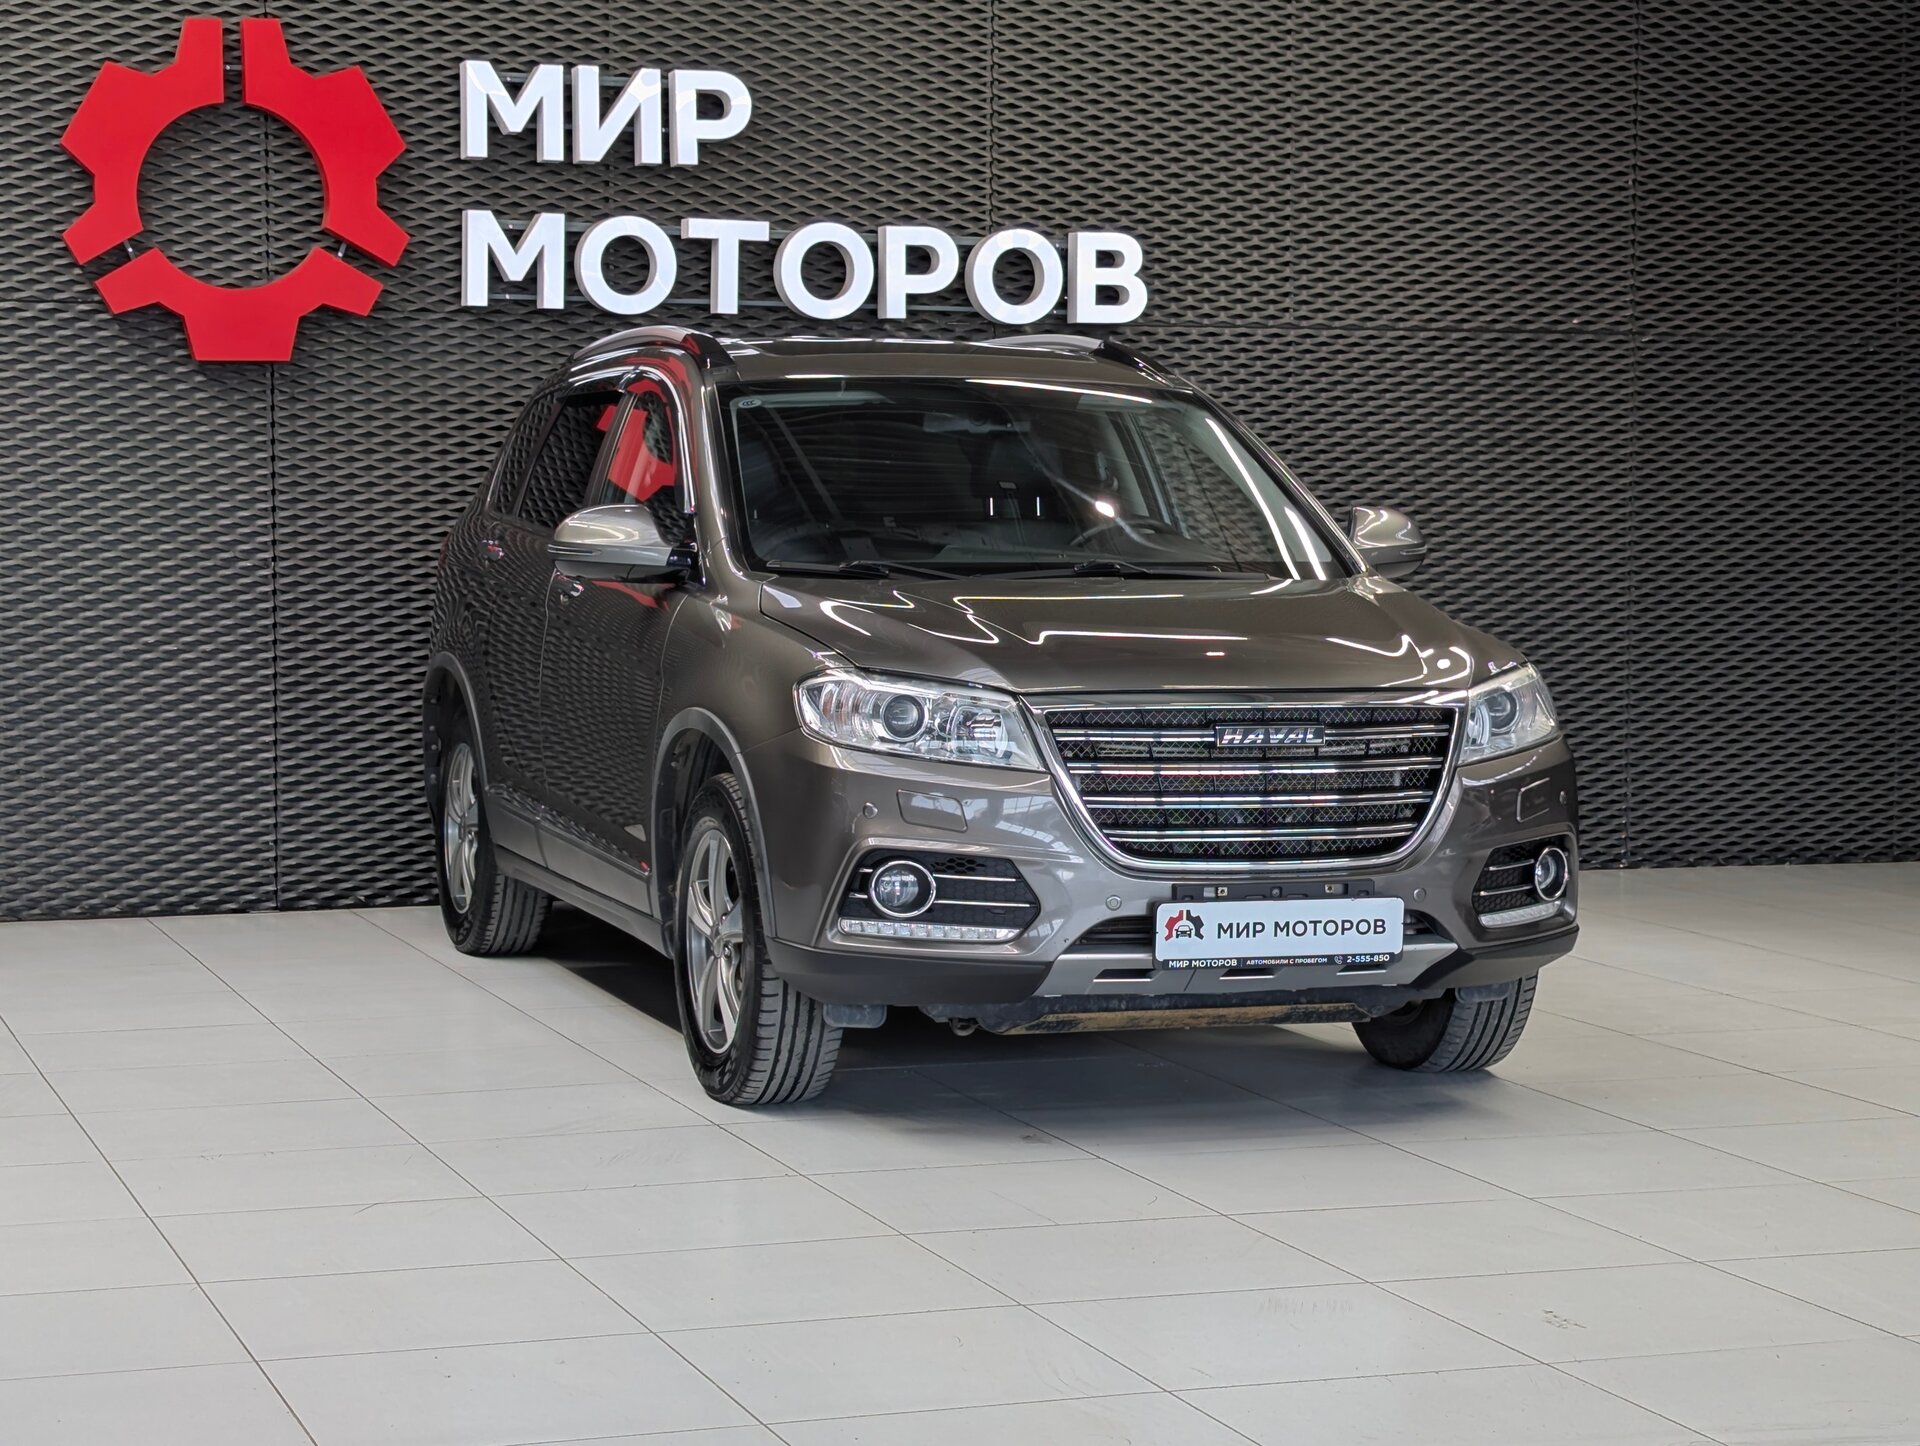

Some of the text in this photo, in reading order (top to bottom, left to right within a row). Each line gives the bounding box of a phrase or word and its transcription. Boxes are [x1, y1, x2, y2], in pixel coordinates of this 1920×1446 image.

[459, 60, 752, 166] МИР
[460, 209, 1149, 325] МОТОРОВ
[1222, 727, 1322, 744] HAVAL
[1217, 918, 1386, 939] МИР МОТОРОВ
[1168, 960, 1190, 968] МИР
[1191, 959, 1238, 967] МОТОРОВ
[1346, 954, 1390, 963] 2-555-850
